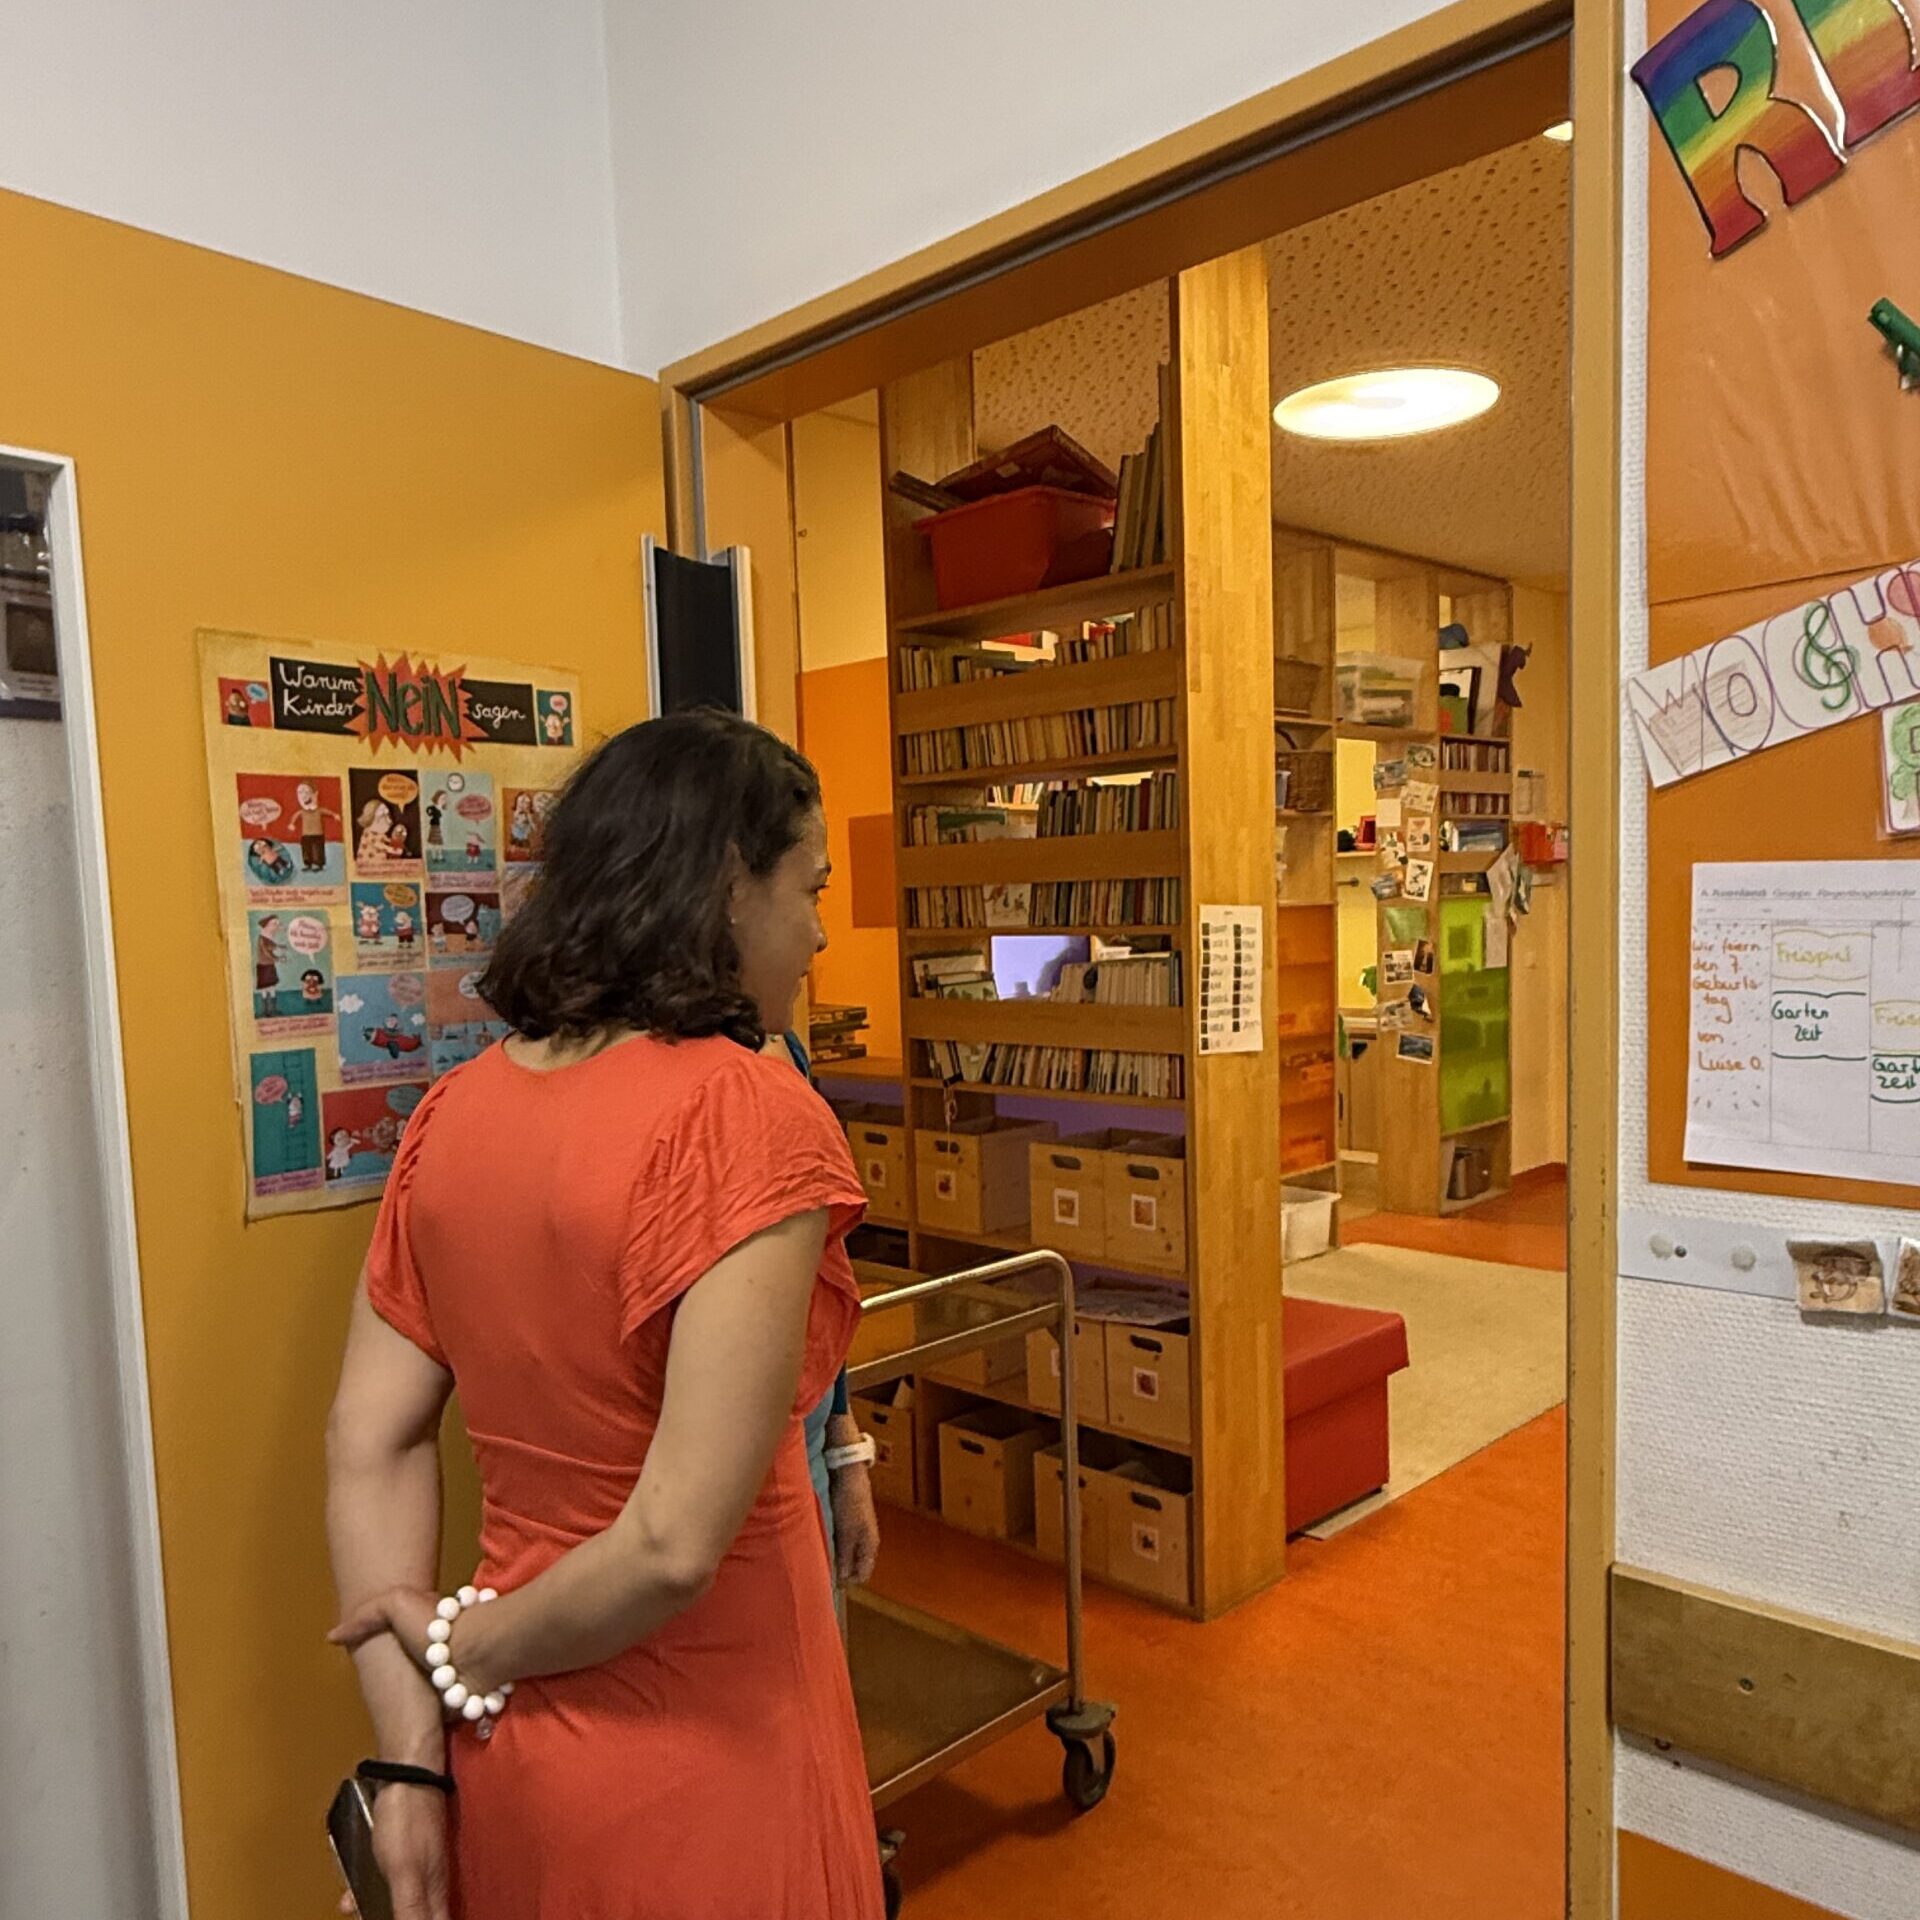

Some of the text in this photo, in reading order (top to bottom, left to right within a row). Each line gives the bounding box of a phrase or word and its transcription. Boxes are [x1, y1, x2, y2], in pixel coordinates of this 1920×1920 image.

[279, 663, 358, 691] Warum
[283, 689, 354, 717] Kinder
[471, 702, 526, 729] sagen
[1771, 1000, 1829, 1020] Garten
